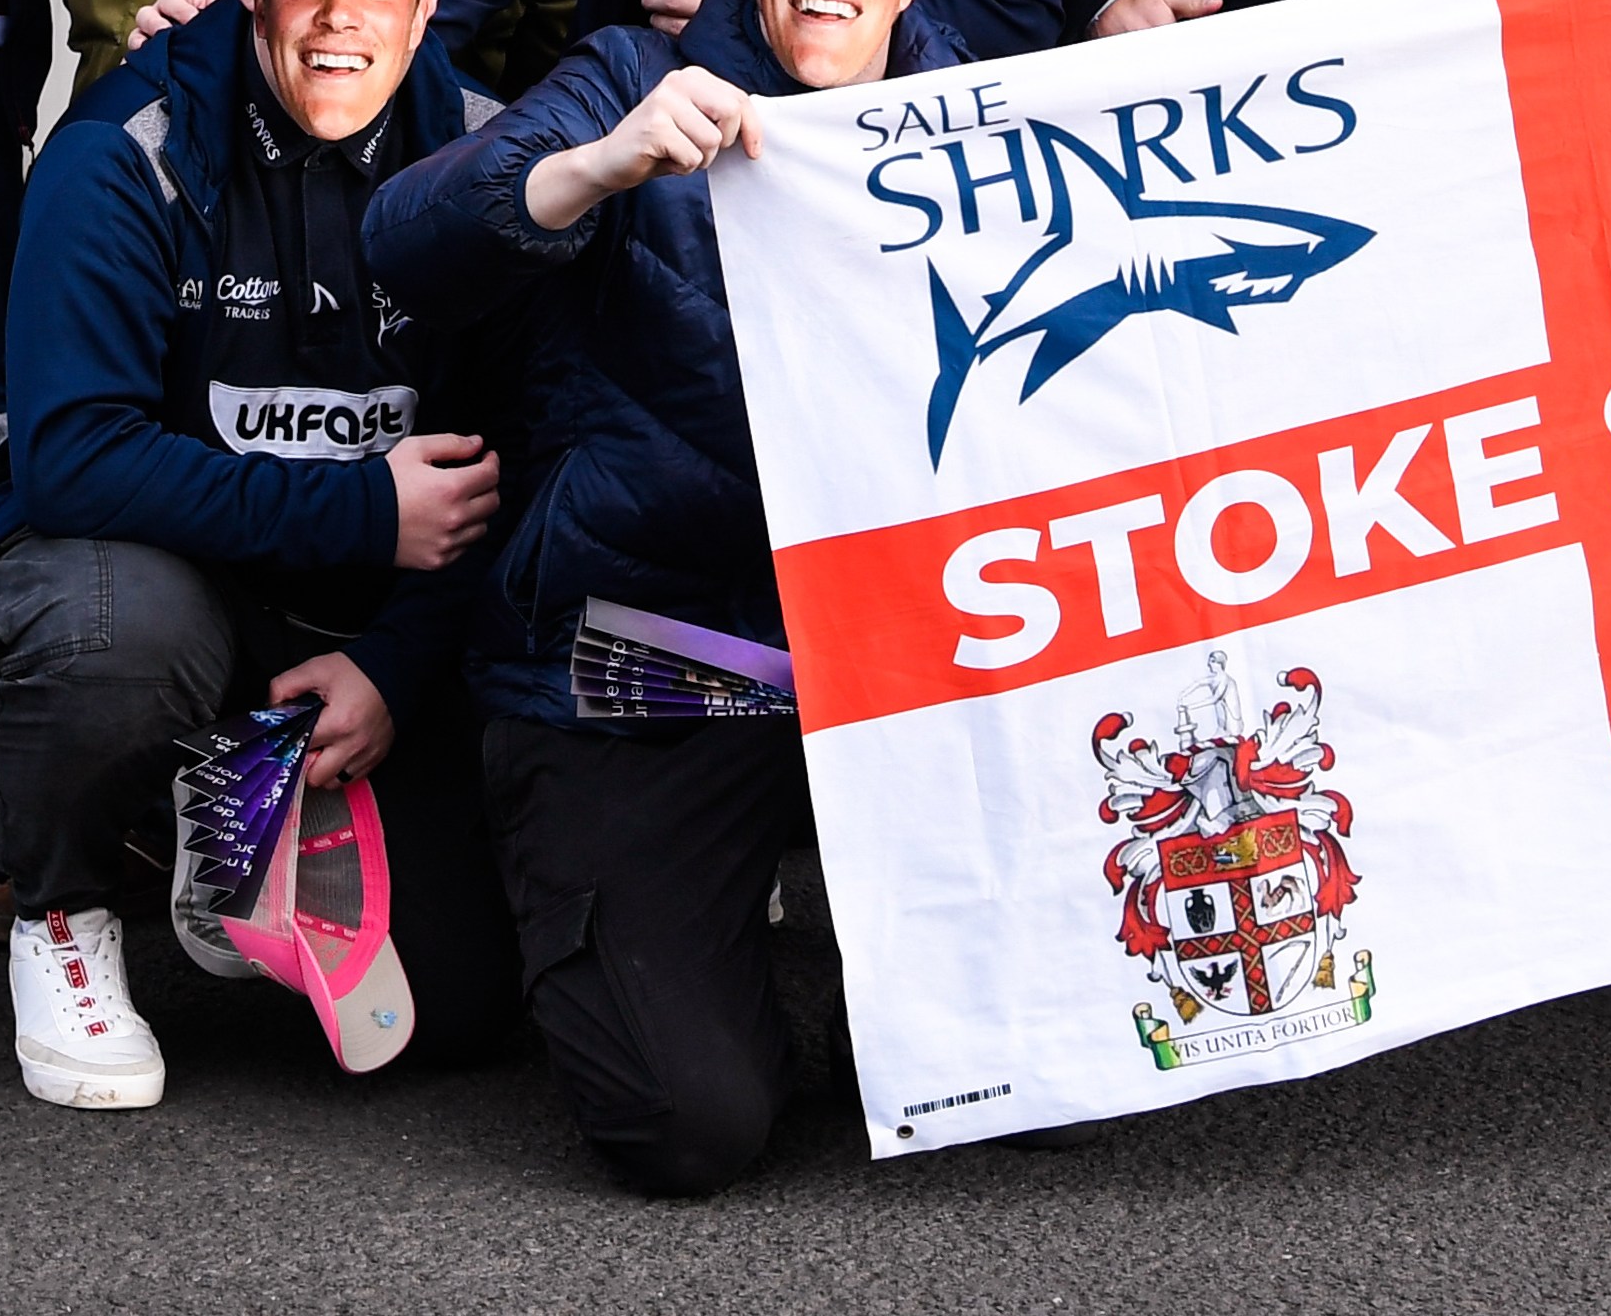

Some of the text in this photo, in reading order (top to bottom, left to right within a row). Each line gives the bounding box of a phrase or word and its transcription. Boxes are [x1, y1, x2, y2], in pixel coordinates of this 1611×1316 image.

[246, 102, 281, 161] SHARKS
[855, 81, 1011, 151] SALE
[866, 57, 1359, 253] SHARKS
[216, 274, 282, 302] Cotton
[941, 395, 1560, 672] STOKE
[1171, 1006, 1356, 1059] VIS UNITA FORTIOR
